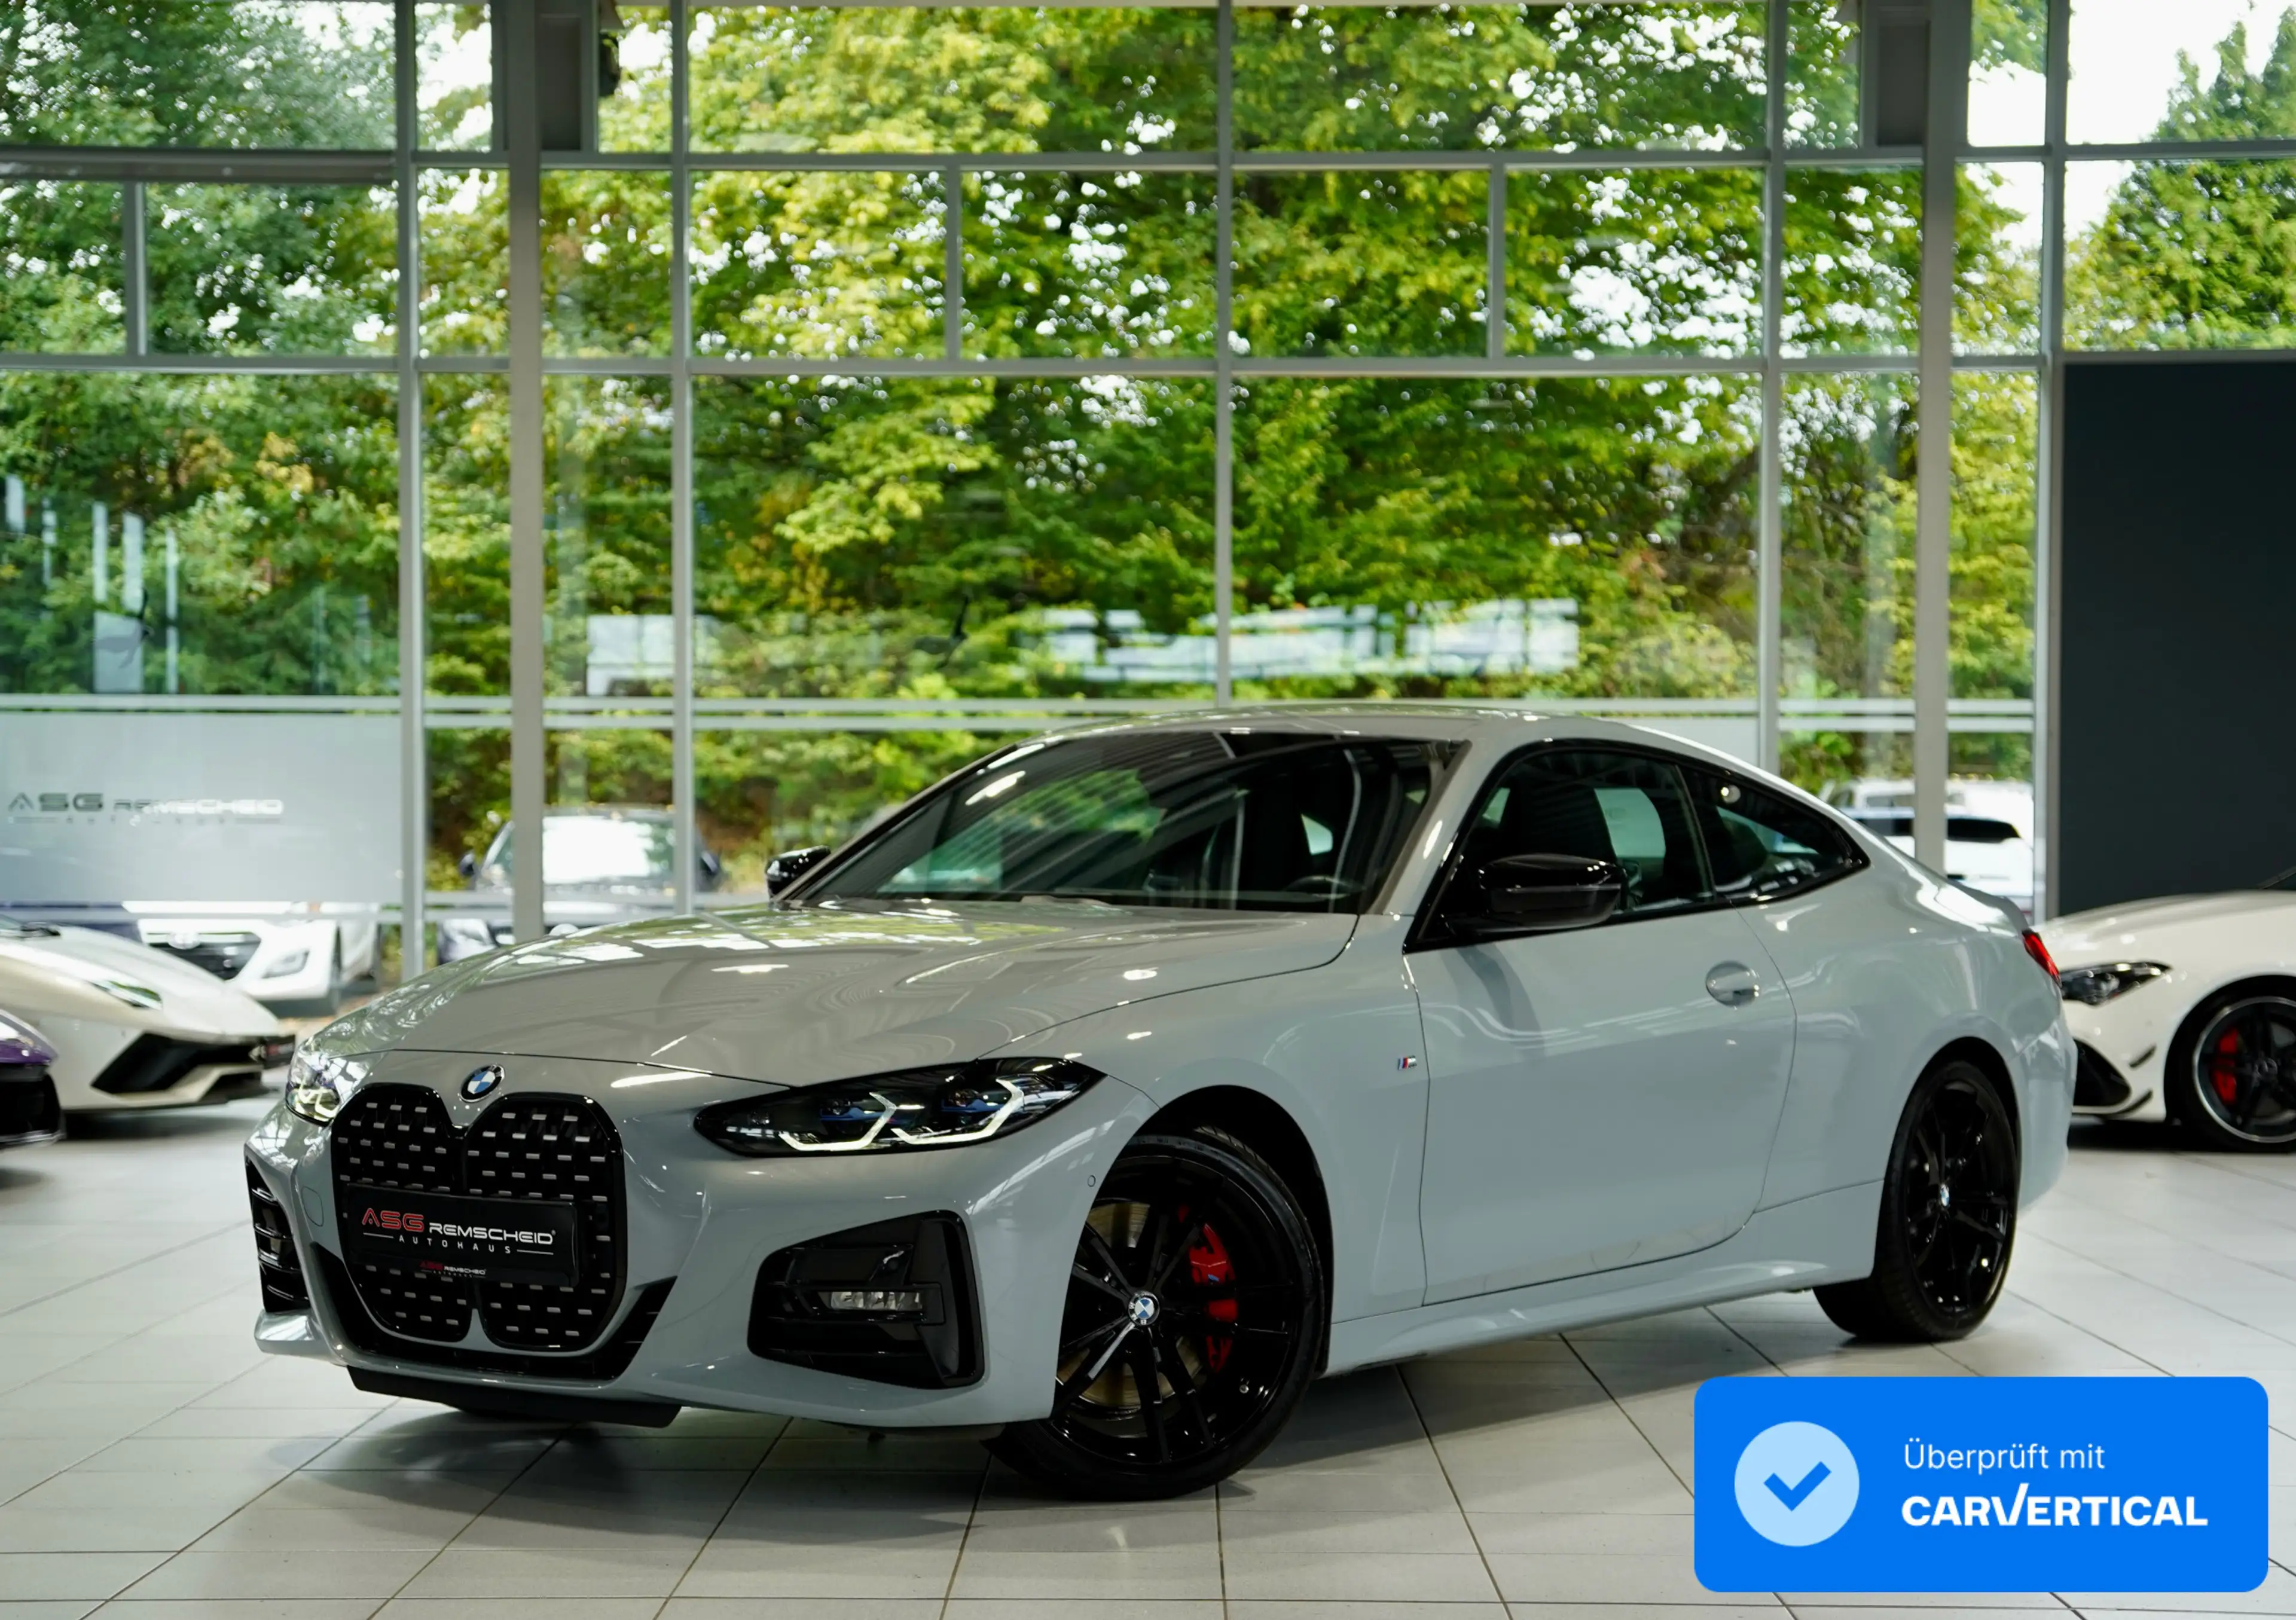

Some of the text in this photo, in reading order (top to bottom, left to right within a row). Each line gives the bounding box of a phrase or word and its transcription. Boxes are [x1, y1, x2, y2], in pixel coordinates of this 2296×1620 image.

[8, 793, 103, 812] ASG
[362, 1208, 554, 1245] ASG REMSCHEID
[398, 1234, 511, 1254] AUTOHAUS
